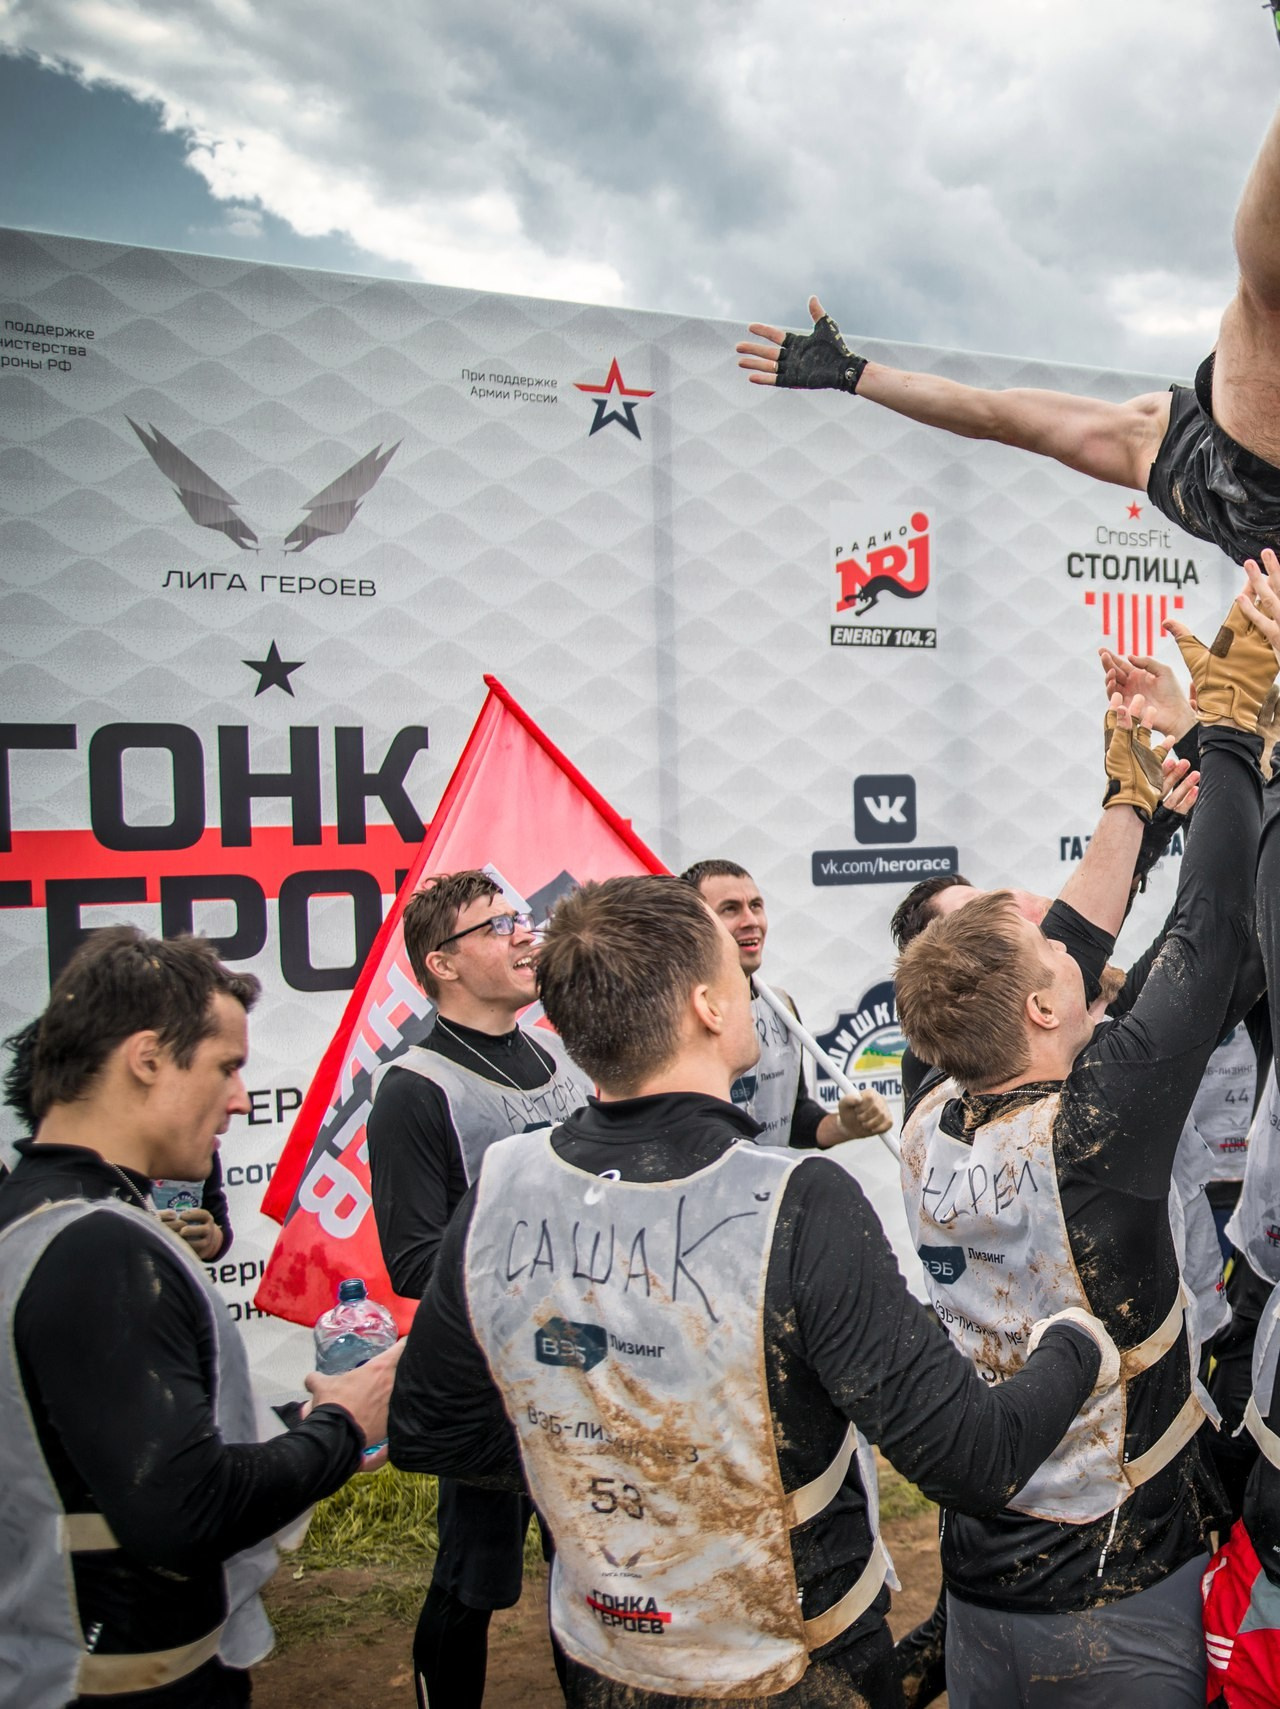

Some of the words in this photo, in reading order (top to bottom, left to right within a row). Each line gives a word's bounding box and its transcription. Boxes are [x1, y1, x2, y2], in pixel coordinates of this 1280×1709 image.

[4, 320, 95, 340] поддержке
[48, 359, 72, 372] РФ
[461, 368, 486, 382] При
[489, 374, 558, 389] поддержке
[470, 386, 510, 400] Армии
[514, 390, 558, 404] России
[835, 526, 908, 557] РАДИО
[1096, 525, 1172, 549] CrossFit
[1067, 552, 1200, 589] СТОЛИЦА
[162, 570, 248, 592] ЛИГА
[260, 574, 377, 597] ГЕРОЕВ
[832, 627, 892, 645] ENERGY
[894, 629, 936, 646] 104.2
[820, 856, 951, 876] vk.com/herorace
[1224, 1088, 1249, 1105] 44
[968, 1247, 1006, 1265] Лизинг
[609, 1333, 666, 1358] Лизинг
[591, 1477, 644, 1520] 53
[592, 1588, 659, 1615] ГОНКА
[591, 1605, 665, 1635] ГЕРОЕВ
